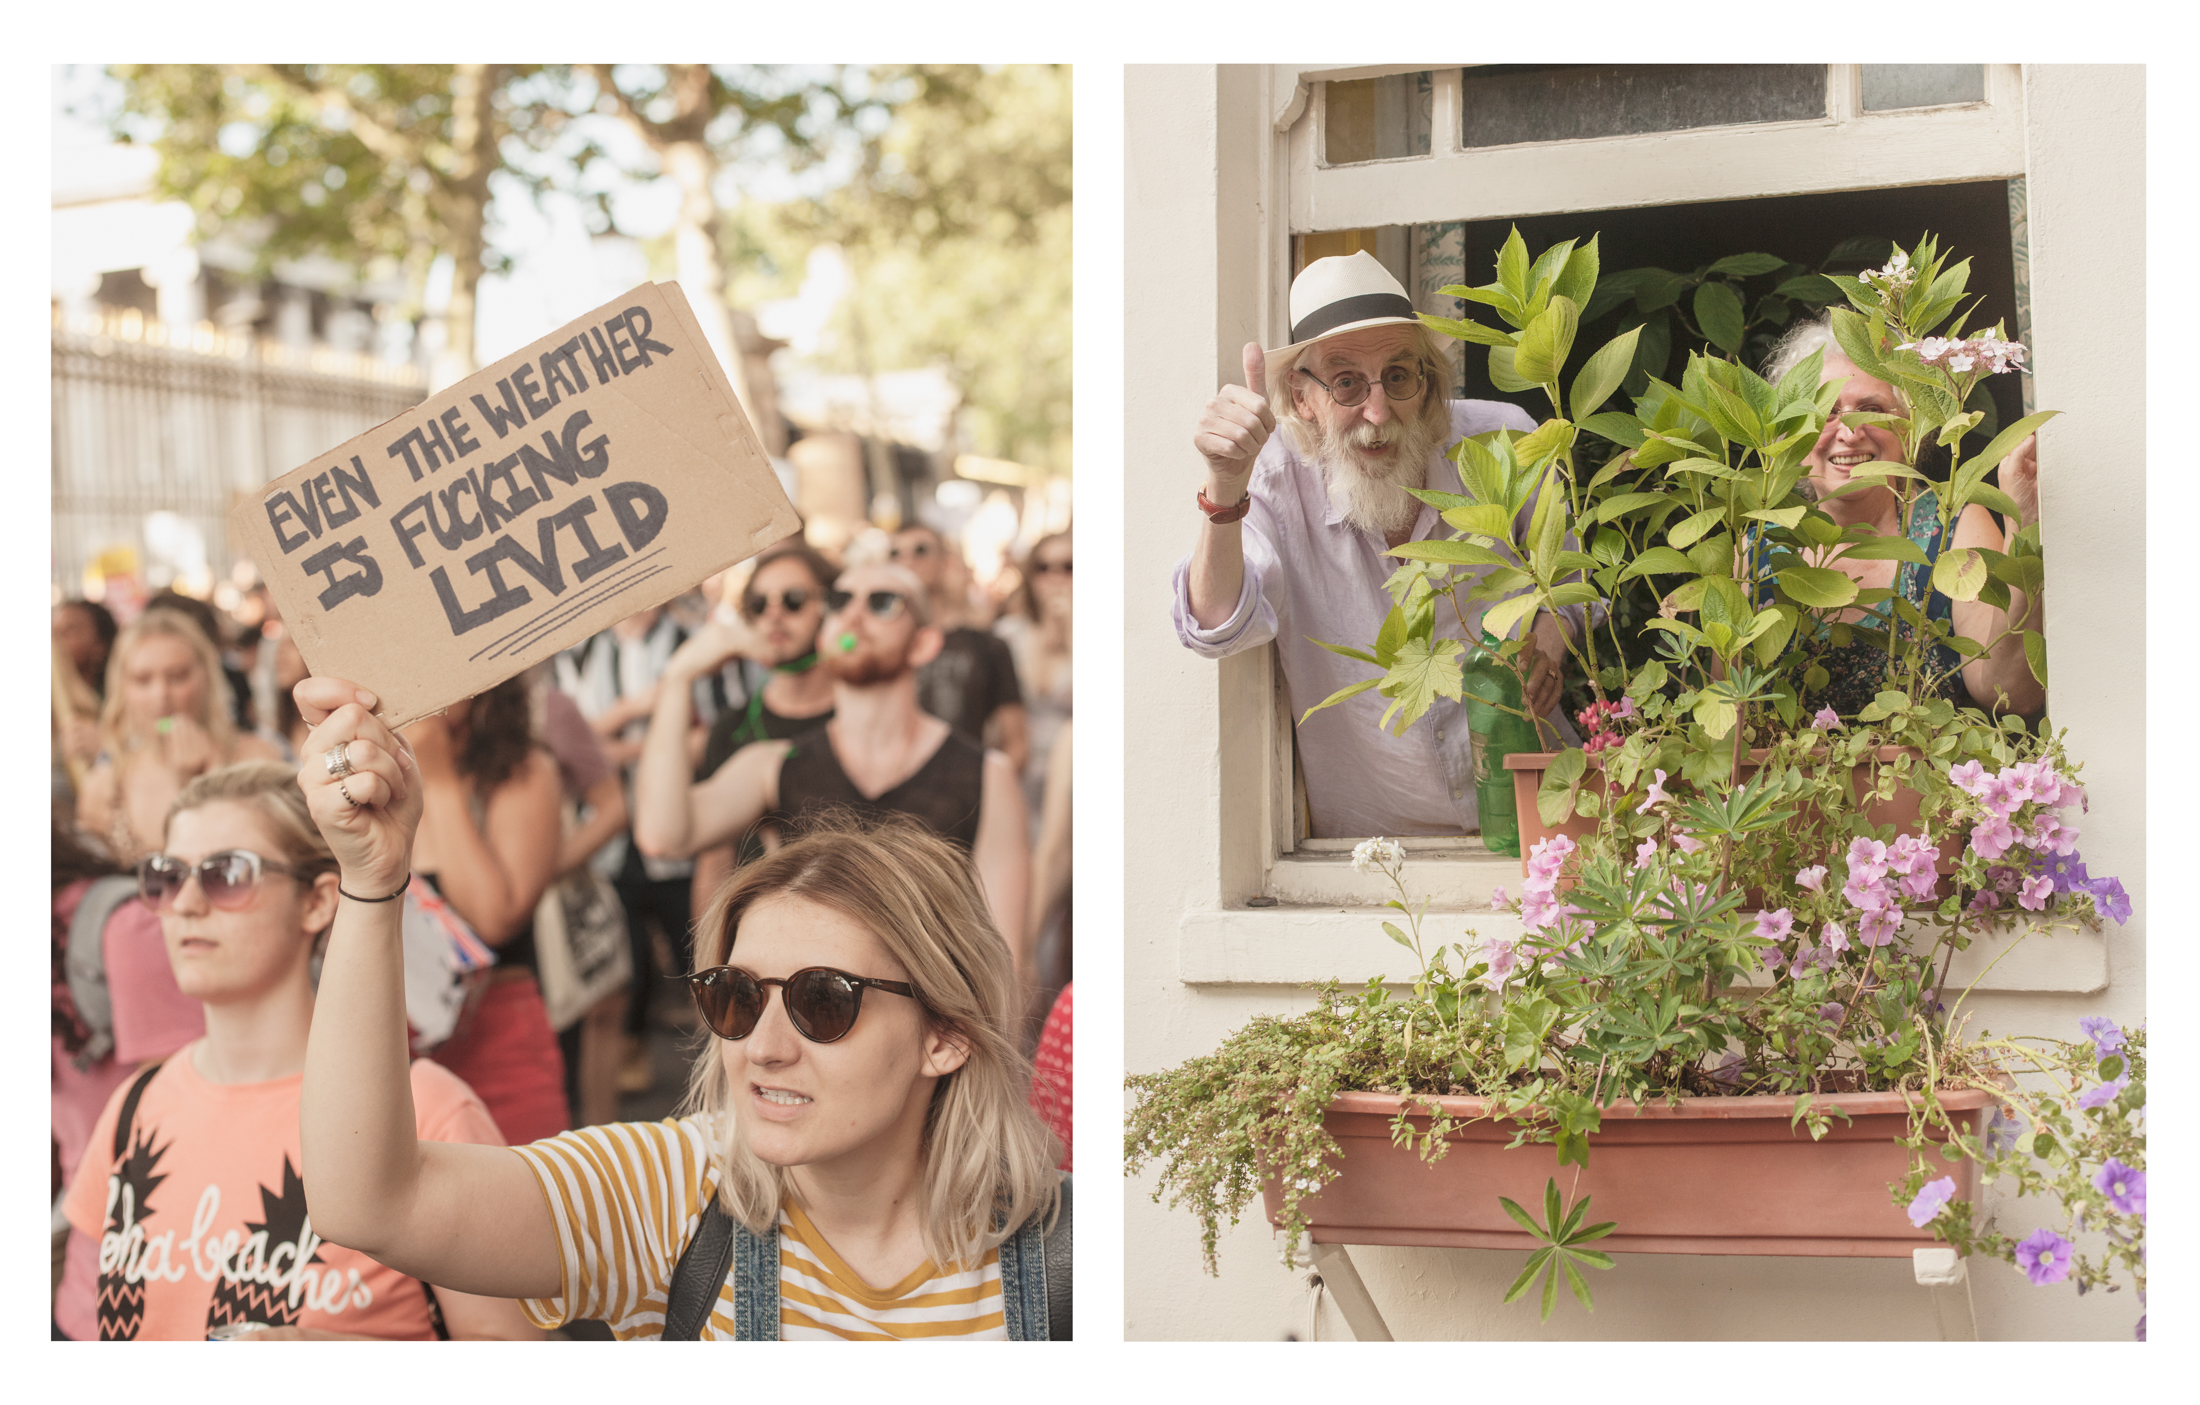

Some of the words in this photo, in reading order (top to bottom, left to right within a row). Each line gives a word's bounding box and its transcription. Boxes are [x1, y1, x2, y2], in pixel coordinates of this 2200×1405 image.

[264, 456, 382, 554] EVEN
[387, 405, 481, 482] THE
[470, 306, 674, 439] WEATHER
[301, 536, 384, 611] IS
[390, 410, 610, 569] FUCKING
[429, 482, 668, 636] LIVID
[179, 1183, 373, 1315] beaches
